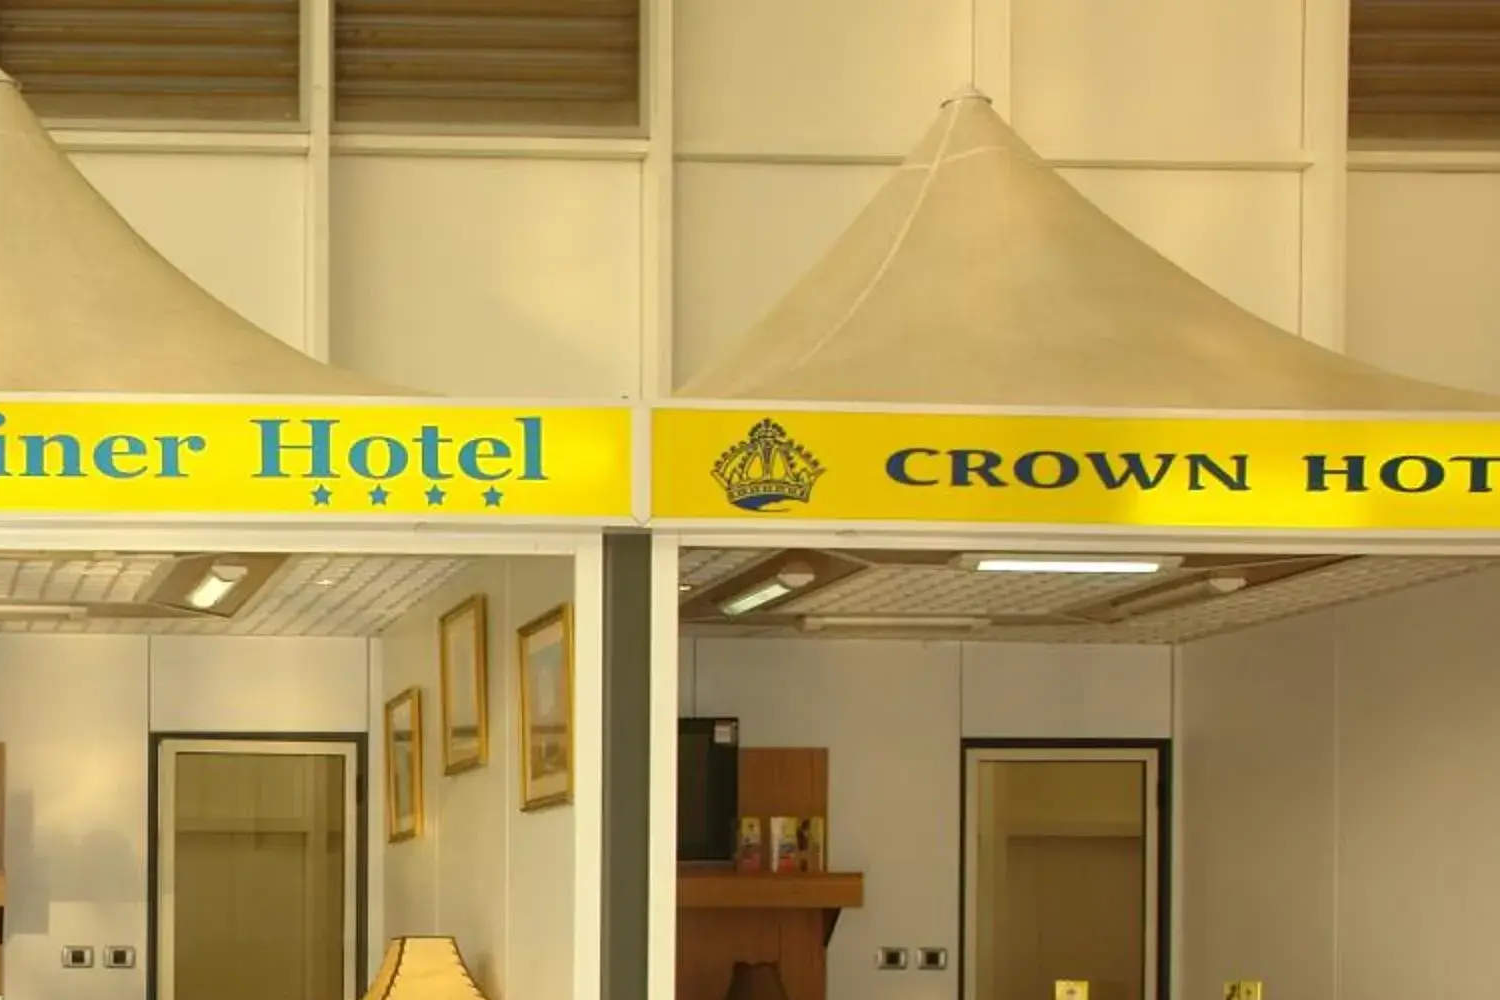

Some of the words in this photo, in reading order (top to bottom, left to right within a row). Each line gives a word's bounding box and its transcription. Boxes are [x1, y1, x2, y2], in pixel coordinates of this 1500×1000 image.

[250, 415, 549, 481] Hotel
[885, 447, 1252, 492] CROWN
[1303, 454, 1500, 493] HOT
